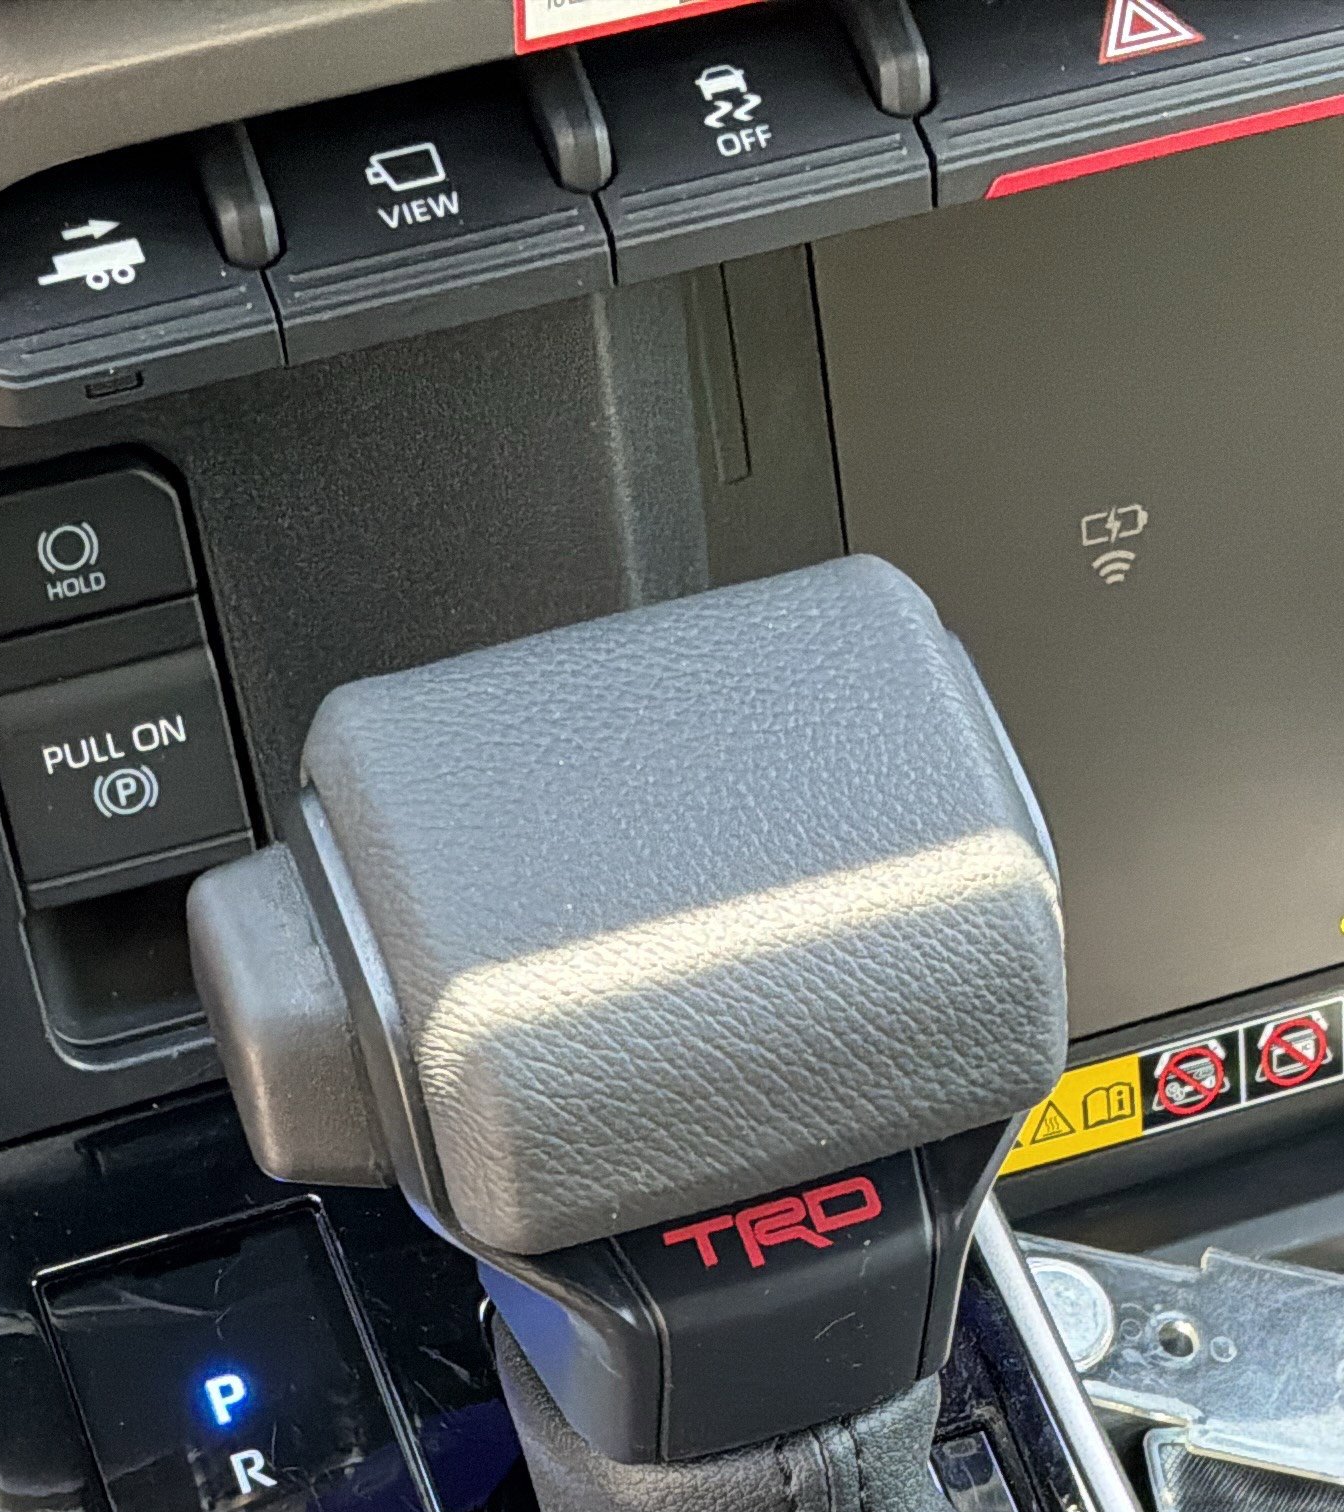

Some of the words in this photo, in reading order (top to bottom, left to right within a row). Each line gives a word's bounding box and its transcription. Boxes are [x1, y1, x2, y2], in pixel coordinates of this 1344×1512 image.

[716, 124, 772, 157] OFF
[378, 191, 459, 229] VIEW
[46, 571, 106, 601] HOLD
[42, 732, 125, 774] PULL
[132, 714, 187, 751] ON
[663, 1177, 882, 1268] TRD
[204, 1374, 246, 1425] P
[230, 1449, 278, 1495] R
